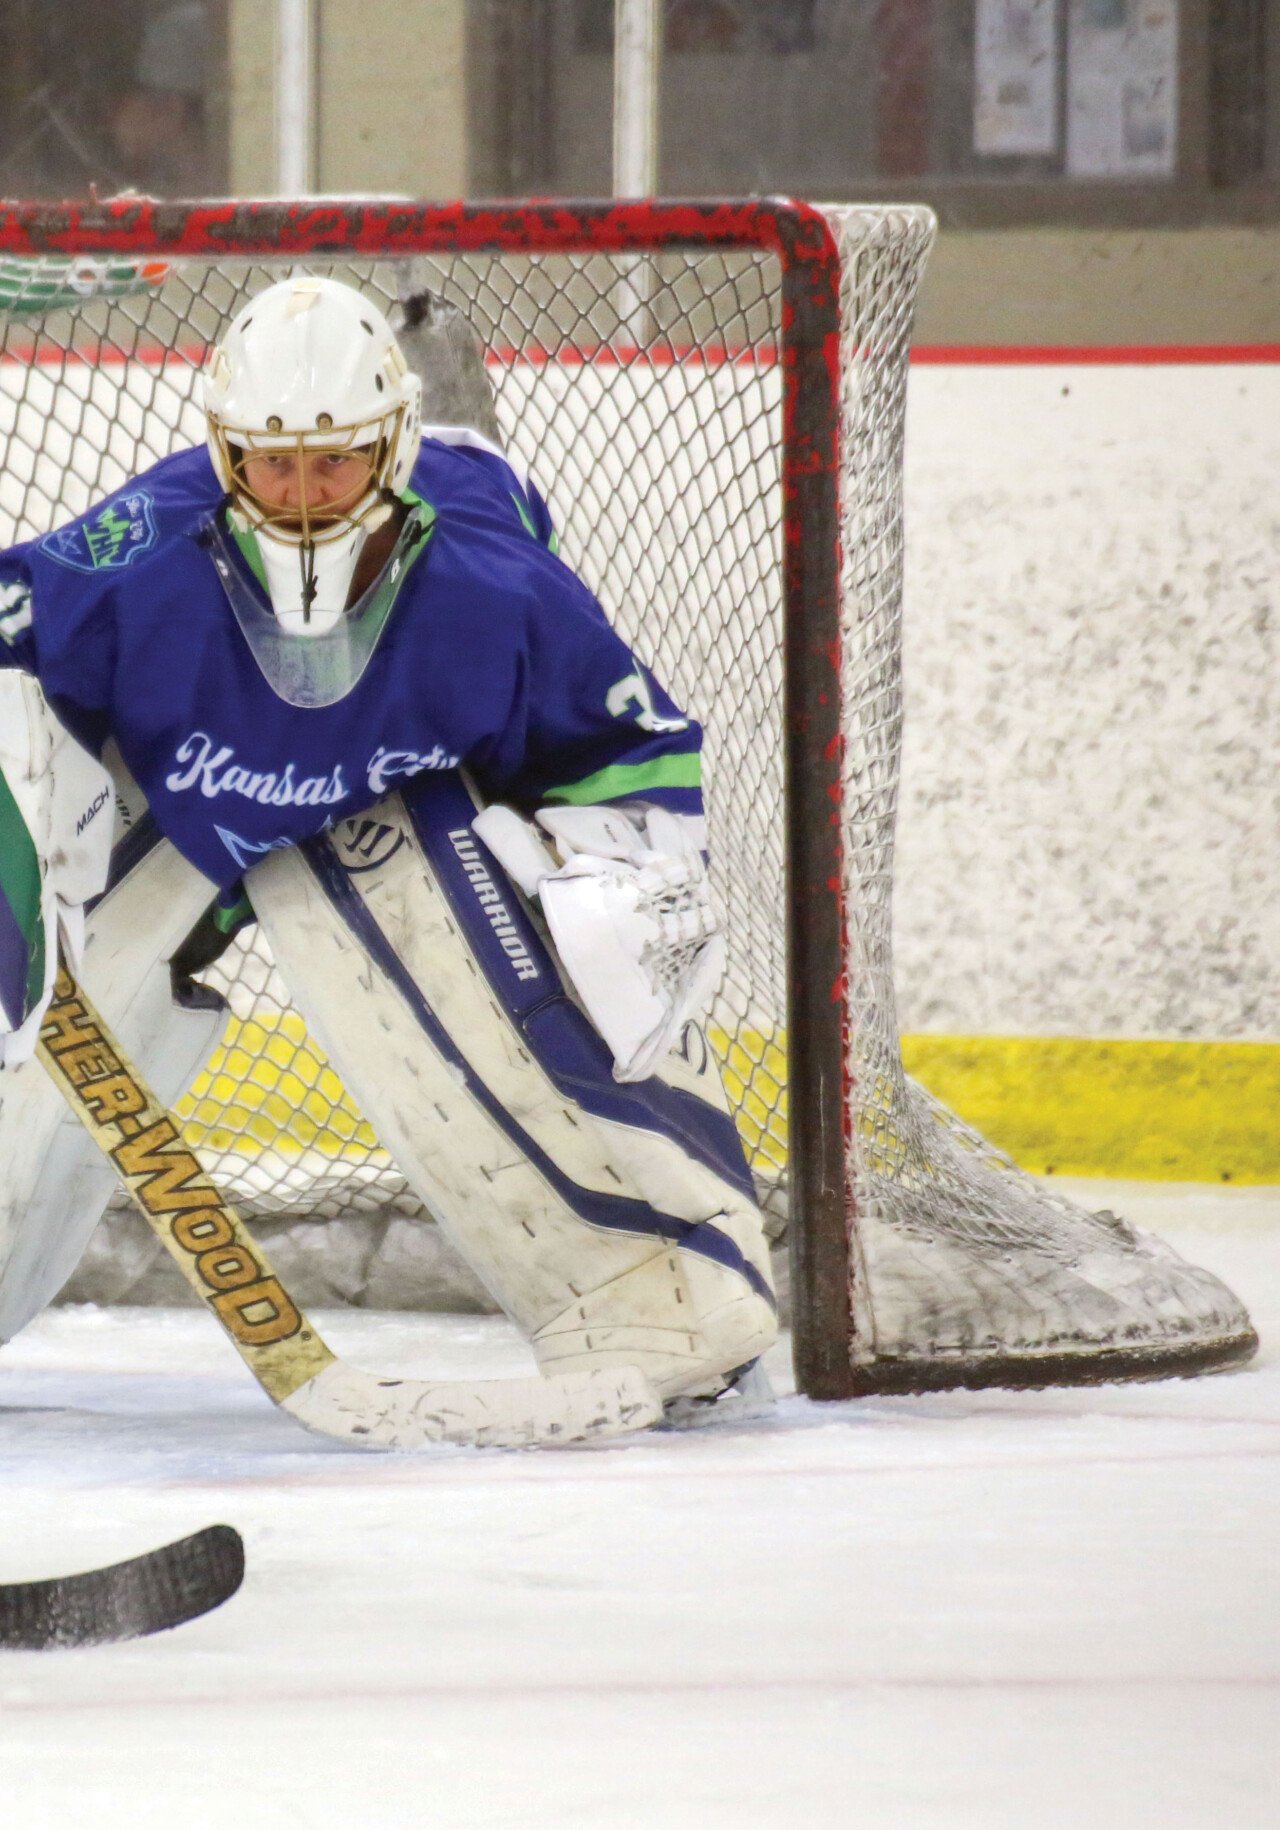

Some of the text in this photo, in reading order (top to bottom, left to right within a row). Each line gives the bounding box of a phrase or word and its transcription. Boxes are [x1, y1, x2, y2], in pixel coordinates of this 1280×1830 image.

[166, 732, 349, 806] Kansas
[77, 785, 109, 837] MACH
[448, 830, 539, 981] WARRIOR
